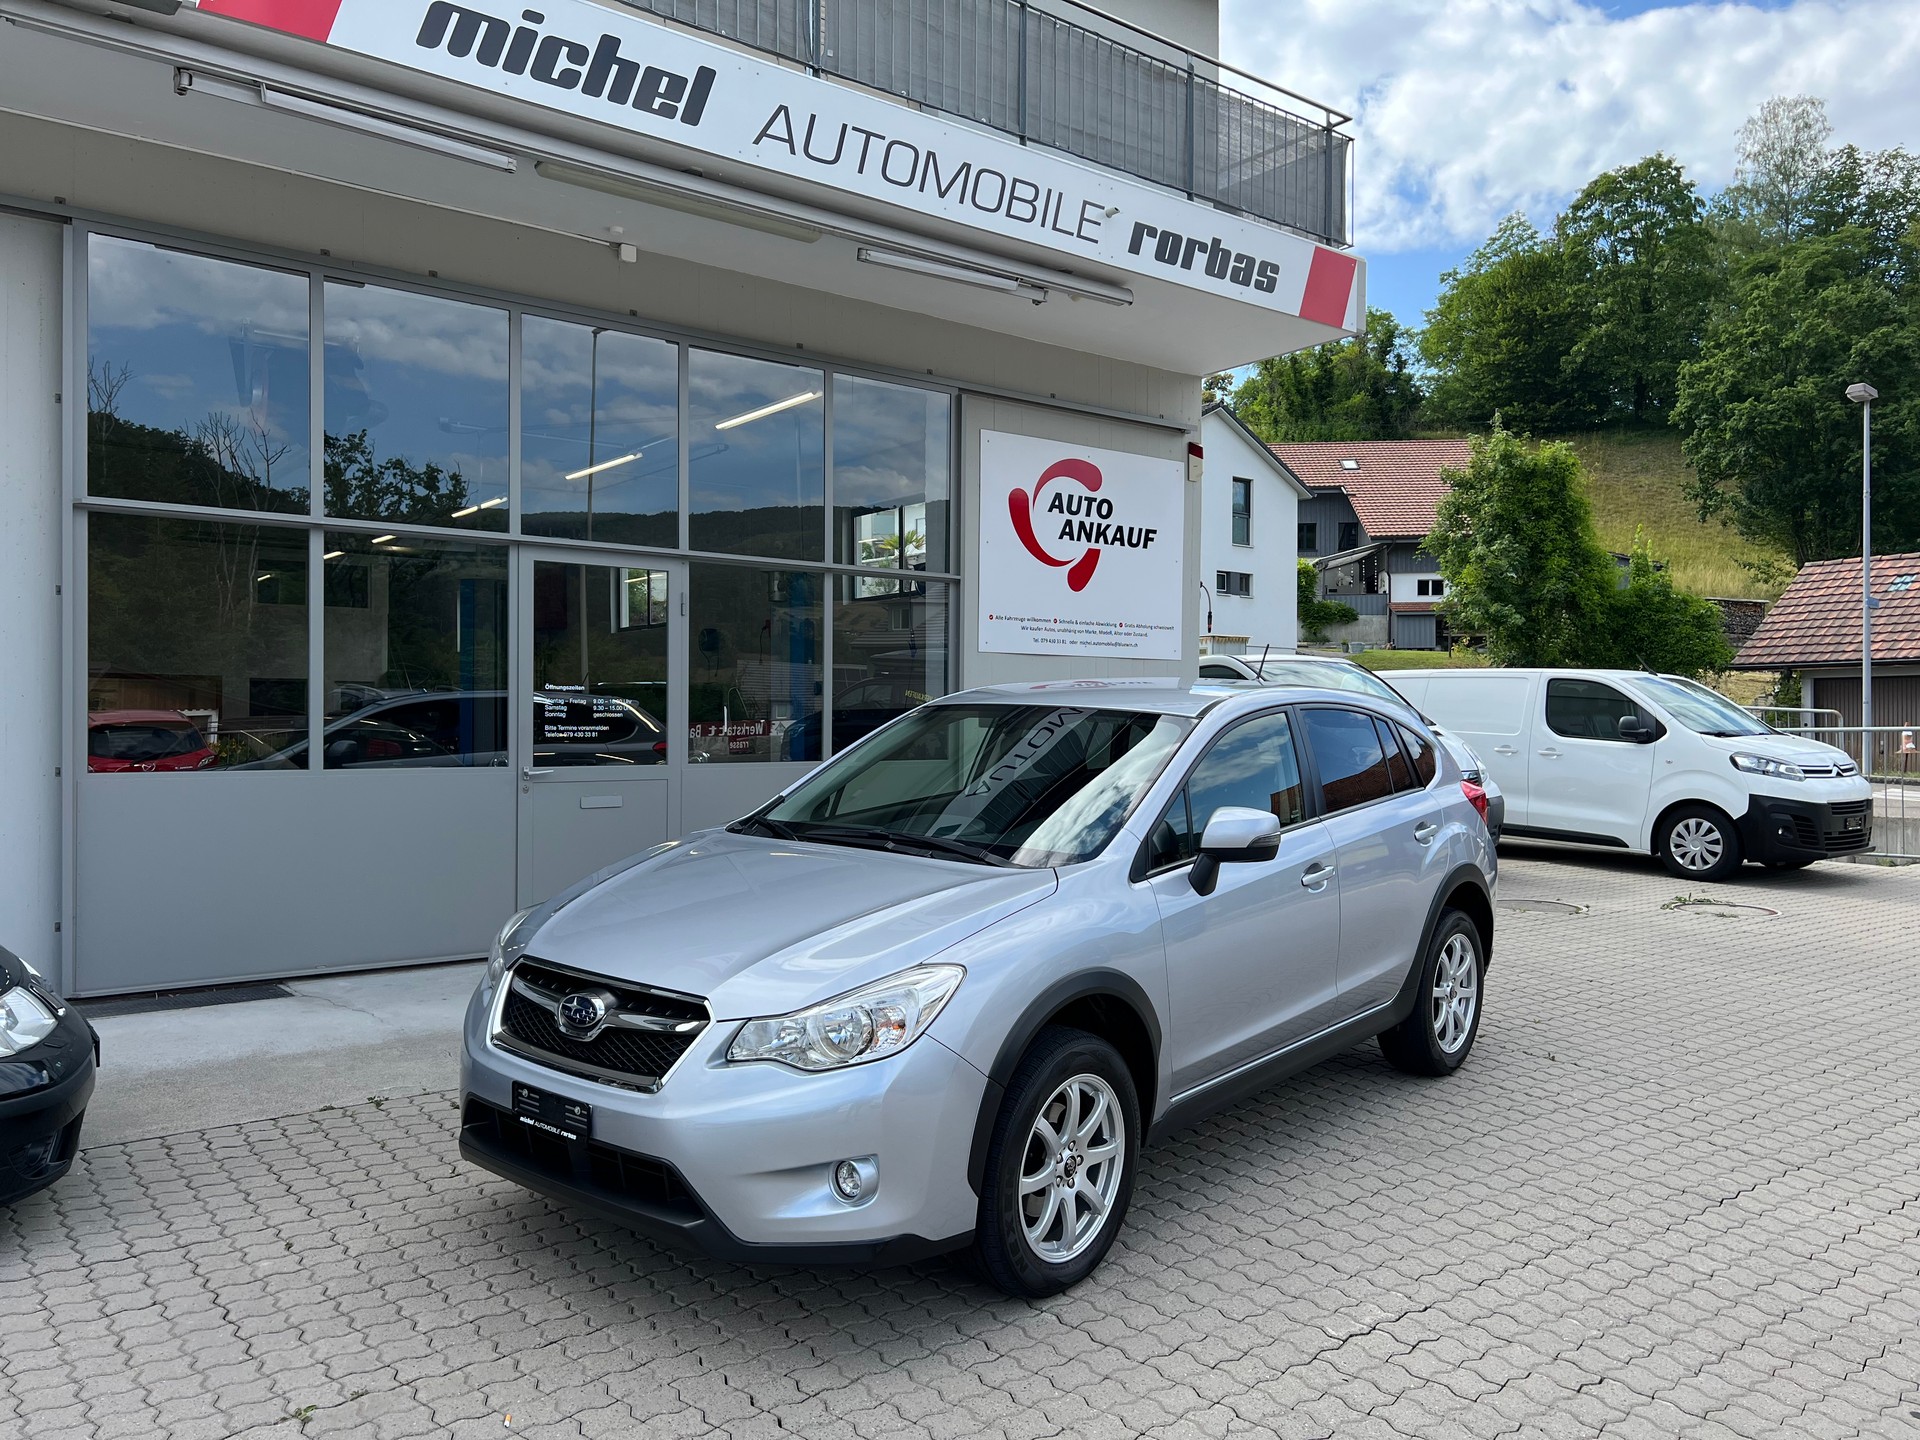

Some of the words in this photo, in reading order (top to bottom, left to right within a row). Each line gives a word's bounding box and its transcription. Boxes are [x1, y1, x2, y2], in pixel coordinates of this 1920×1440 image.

[416, 1, 716, 126] michel
[753, 104, 1106, 244] AUTOMOBILE
[1127, 222, 1279, 293] rorbas
[1047, 492, 1114, 520] AUTO
[1058, 519, 1158, 549] ANKAUF
[535, 1122, 560, 1134] AUTOMOBILE
